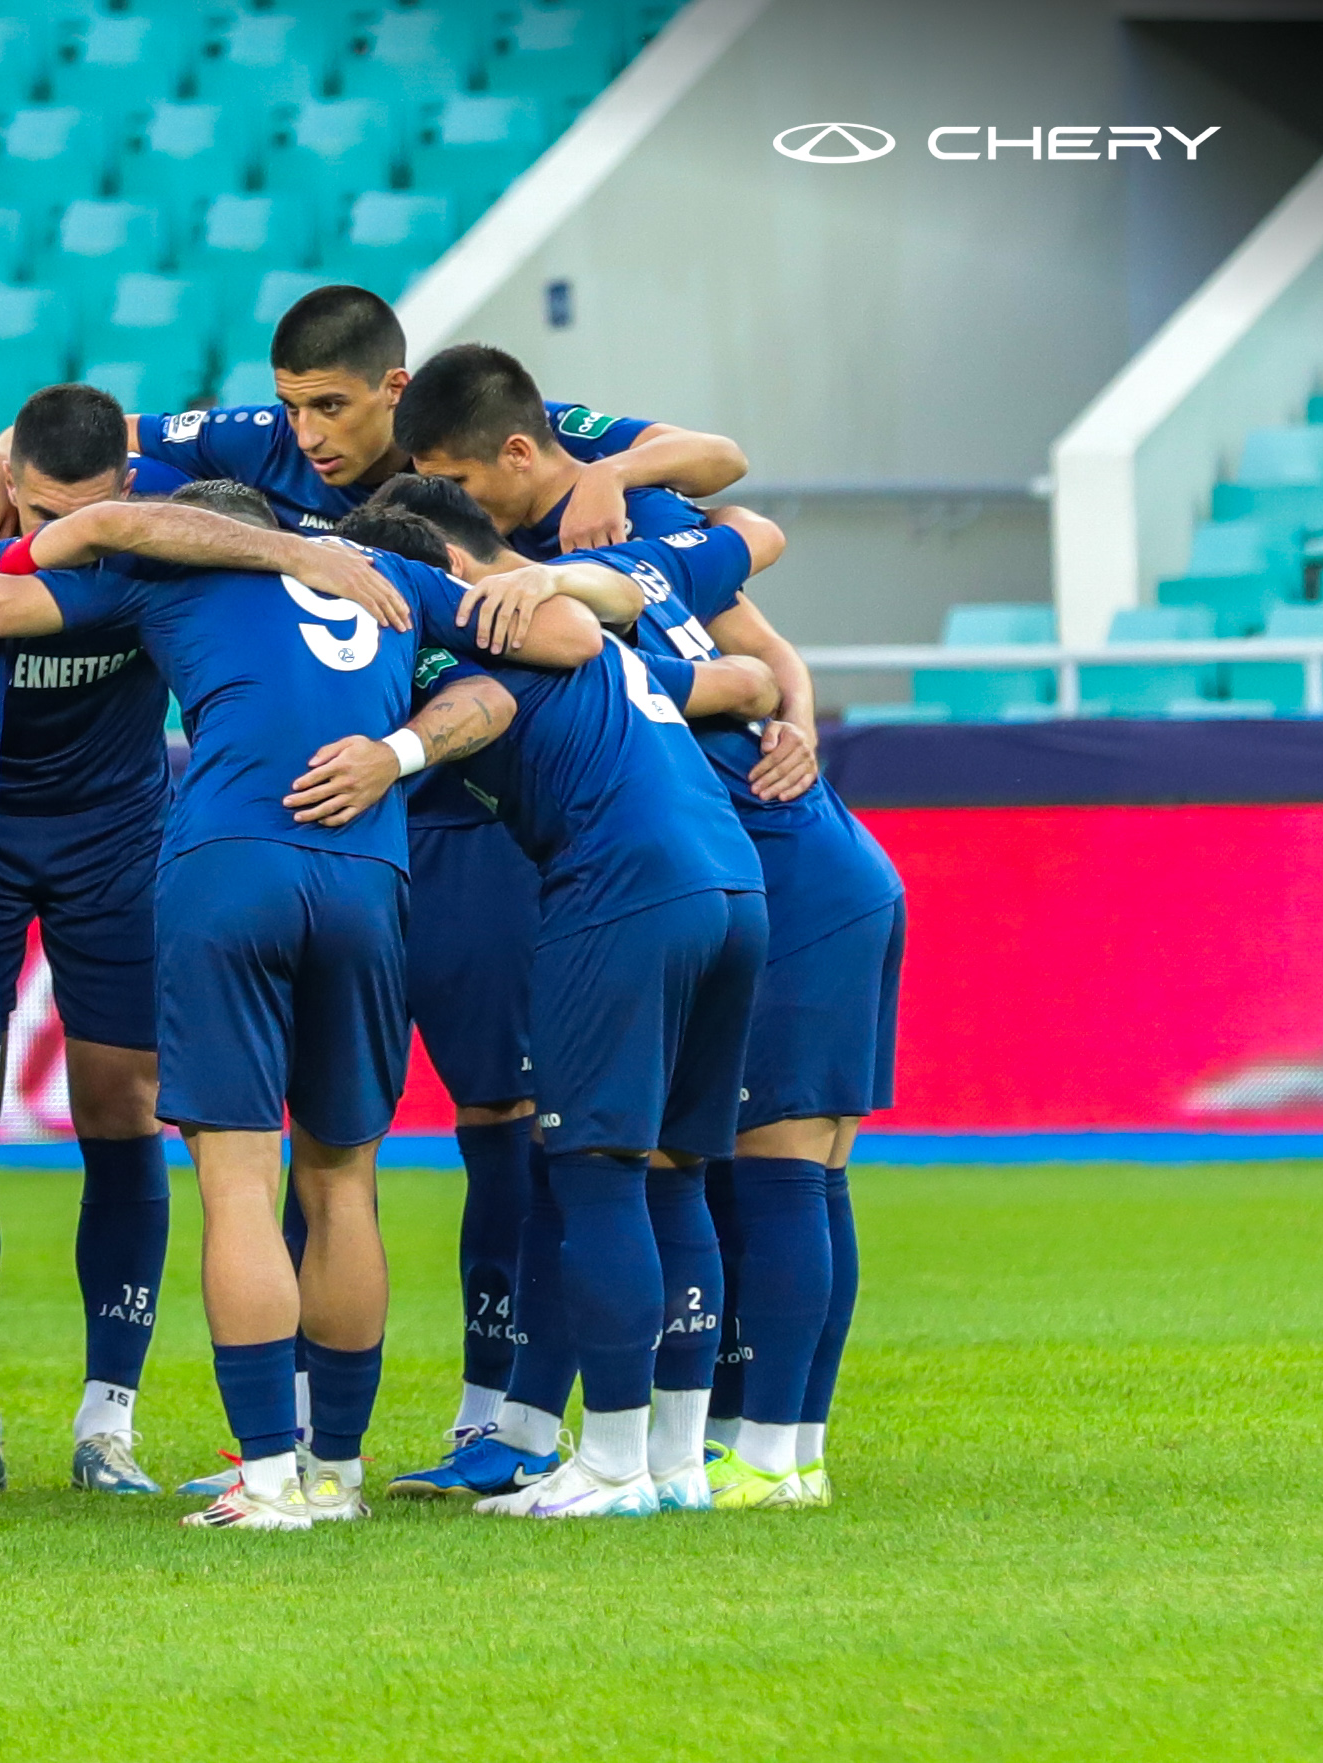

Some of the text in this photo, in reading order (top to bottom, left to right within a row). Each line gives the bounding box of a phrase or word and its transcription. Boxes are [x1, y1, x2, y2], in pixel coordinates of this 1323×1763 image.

[280, 574, 380, 672] 9
[8, 646, 140, 689] EKNEFTEG
[122, 1283, 150, 1310] 15
[687, 1286, 702, 1311] 2
[99, 1303, 154, 1327] JAKO
